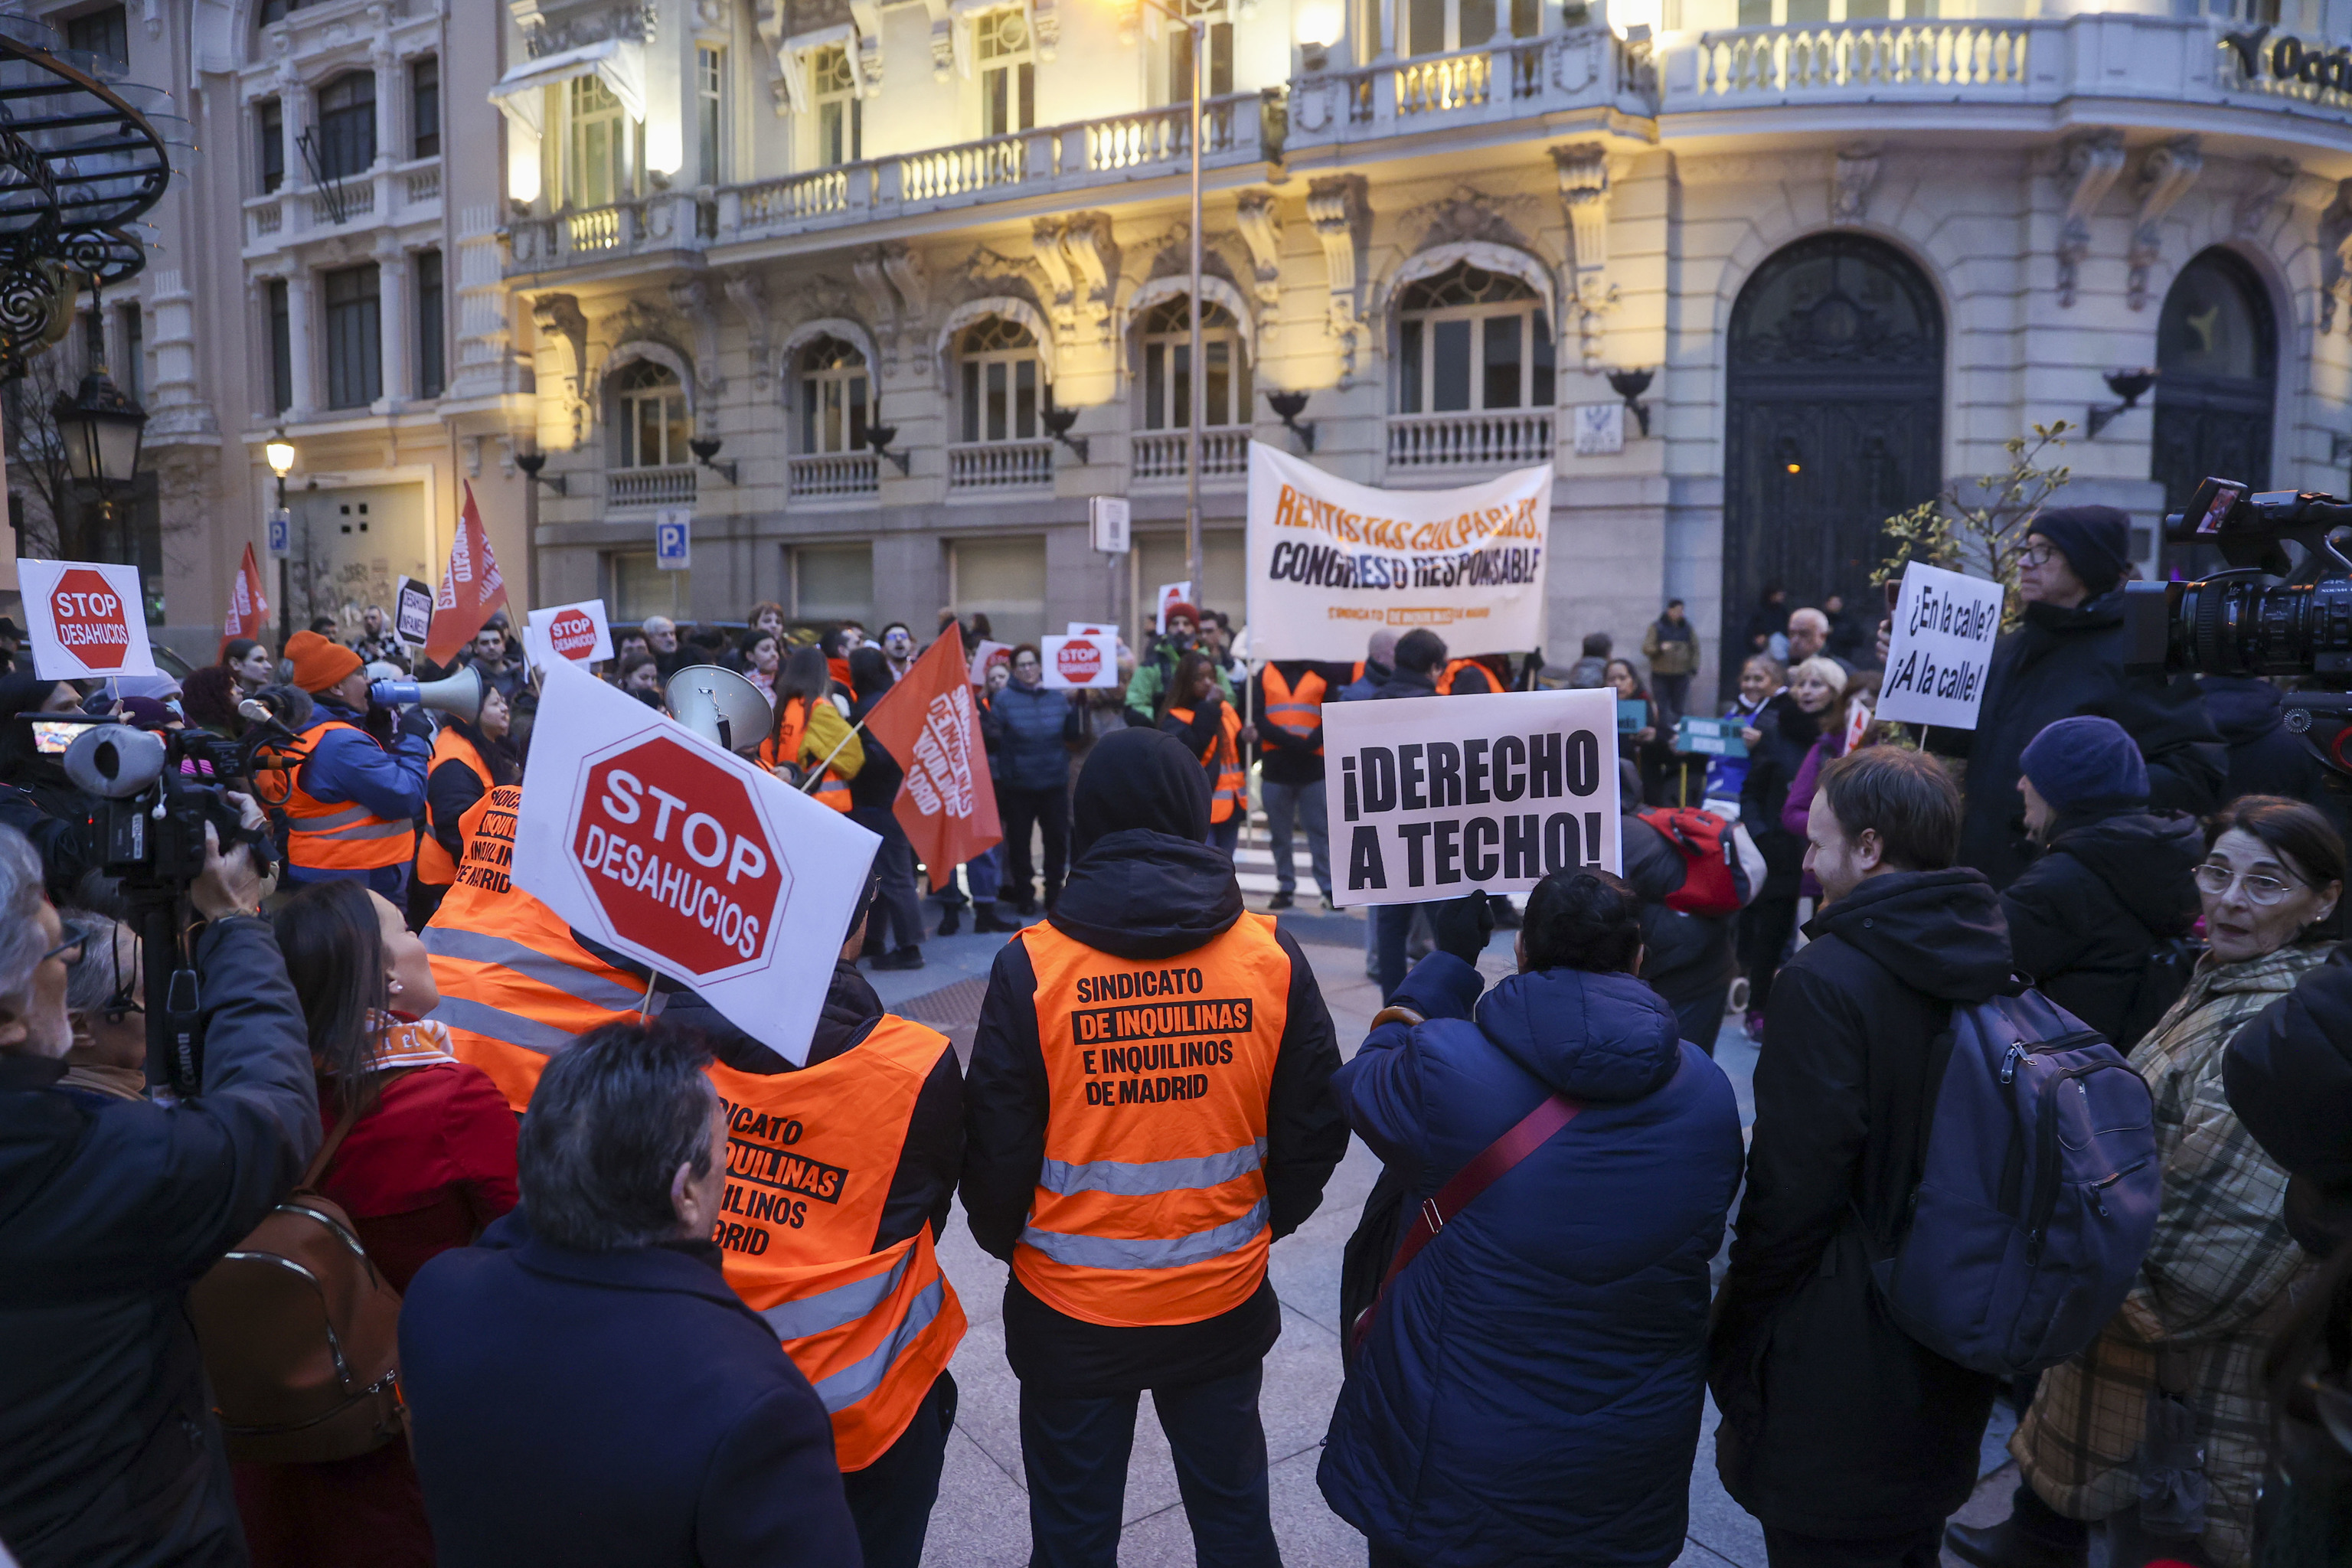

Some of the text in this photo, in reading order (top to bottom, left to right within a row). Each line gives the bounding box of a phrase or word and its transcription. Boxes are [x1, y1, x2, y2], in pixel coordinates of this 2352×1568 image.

[1275, 484, 1412, 550] RENTISTAS
[272, 524, 283, 547] P
[662, 528, 680, 555] P
[1269, 541, 1541, 590] CONGRESO RESPONSABLE
[56, 592, 118, 618] STOP
[1909, 585, 1995, 642] ¿En la calle?
[59, 623, 129, 645] DESAHUCIOS
[552, 617, 590, 638] STOP
[1060, 648, 1099, 662] STOP
[1884, 649, 1984, 703] ¡A la calle!
[1342, 730, 1599, 822] ¡DERECHO
[602, 769, 766, 884] STOP
[1348, 812, 1602, 890] A TECHO!
[582, 823, 760, 959] DESAHUCIOS
[1076, 968, 1204, 1003] SINDICATO
[1079, 1003, 1248, 1040] DE INQUILINAS
[1083, 1039, 1233, 1074] E INQUILINOS
[1086, 1073, 1208, 1106] DE MADRID
